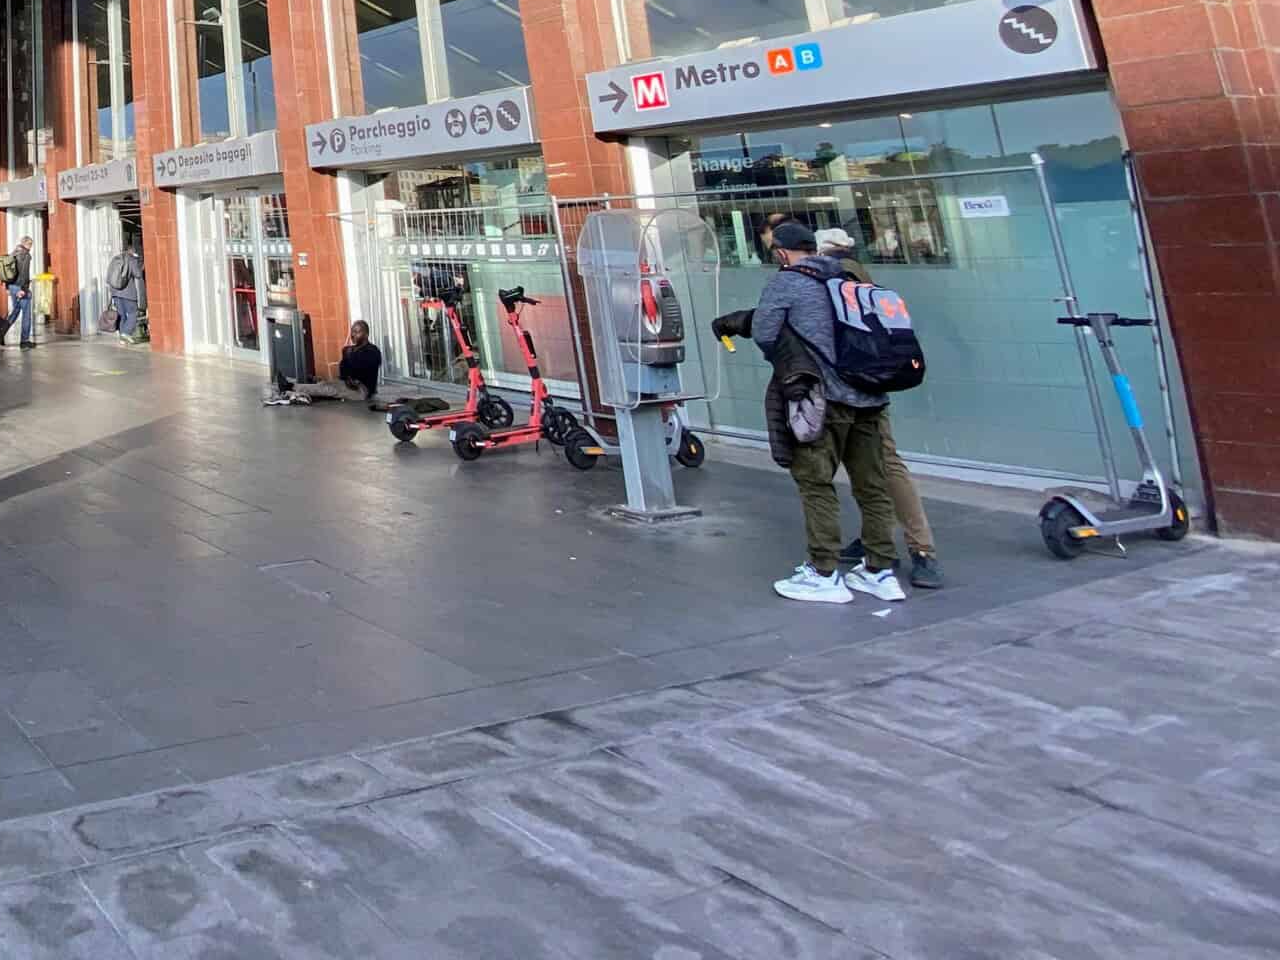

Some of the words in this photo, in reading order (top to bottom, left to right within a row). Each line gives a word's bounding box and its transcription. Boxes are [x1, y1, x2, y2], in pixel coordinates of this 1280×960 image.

[636, 76, 665, 107] M
[675, 60, 760, 90] Metro
[774, 54, 789, 69] A
[800, 49, 816, 65] B
[349, 114, 431, 141] Parcheggio
[177, 151, 214, 168] Deposito
[216, 143, 252, 163] bagagli
